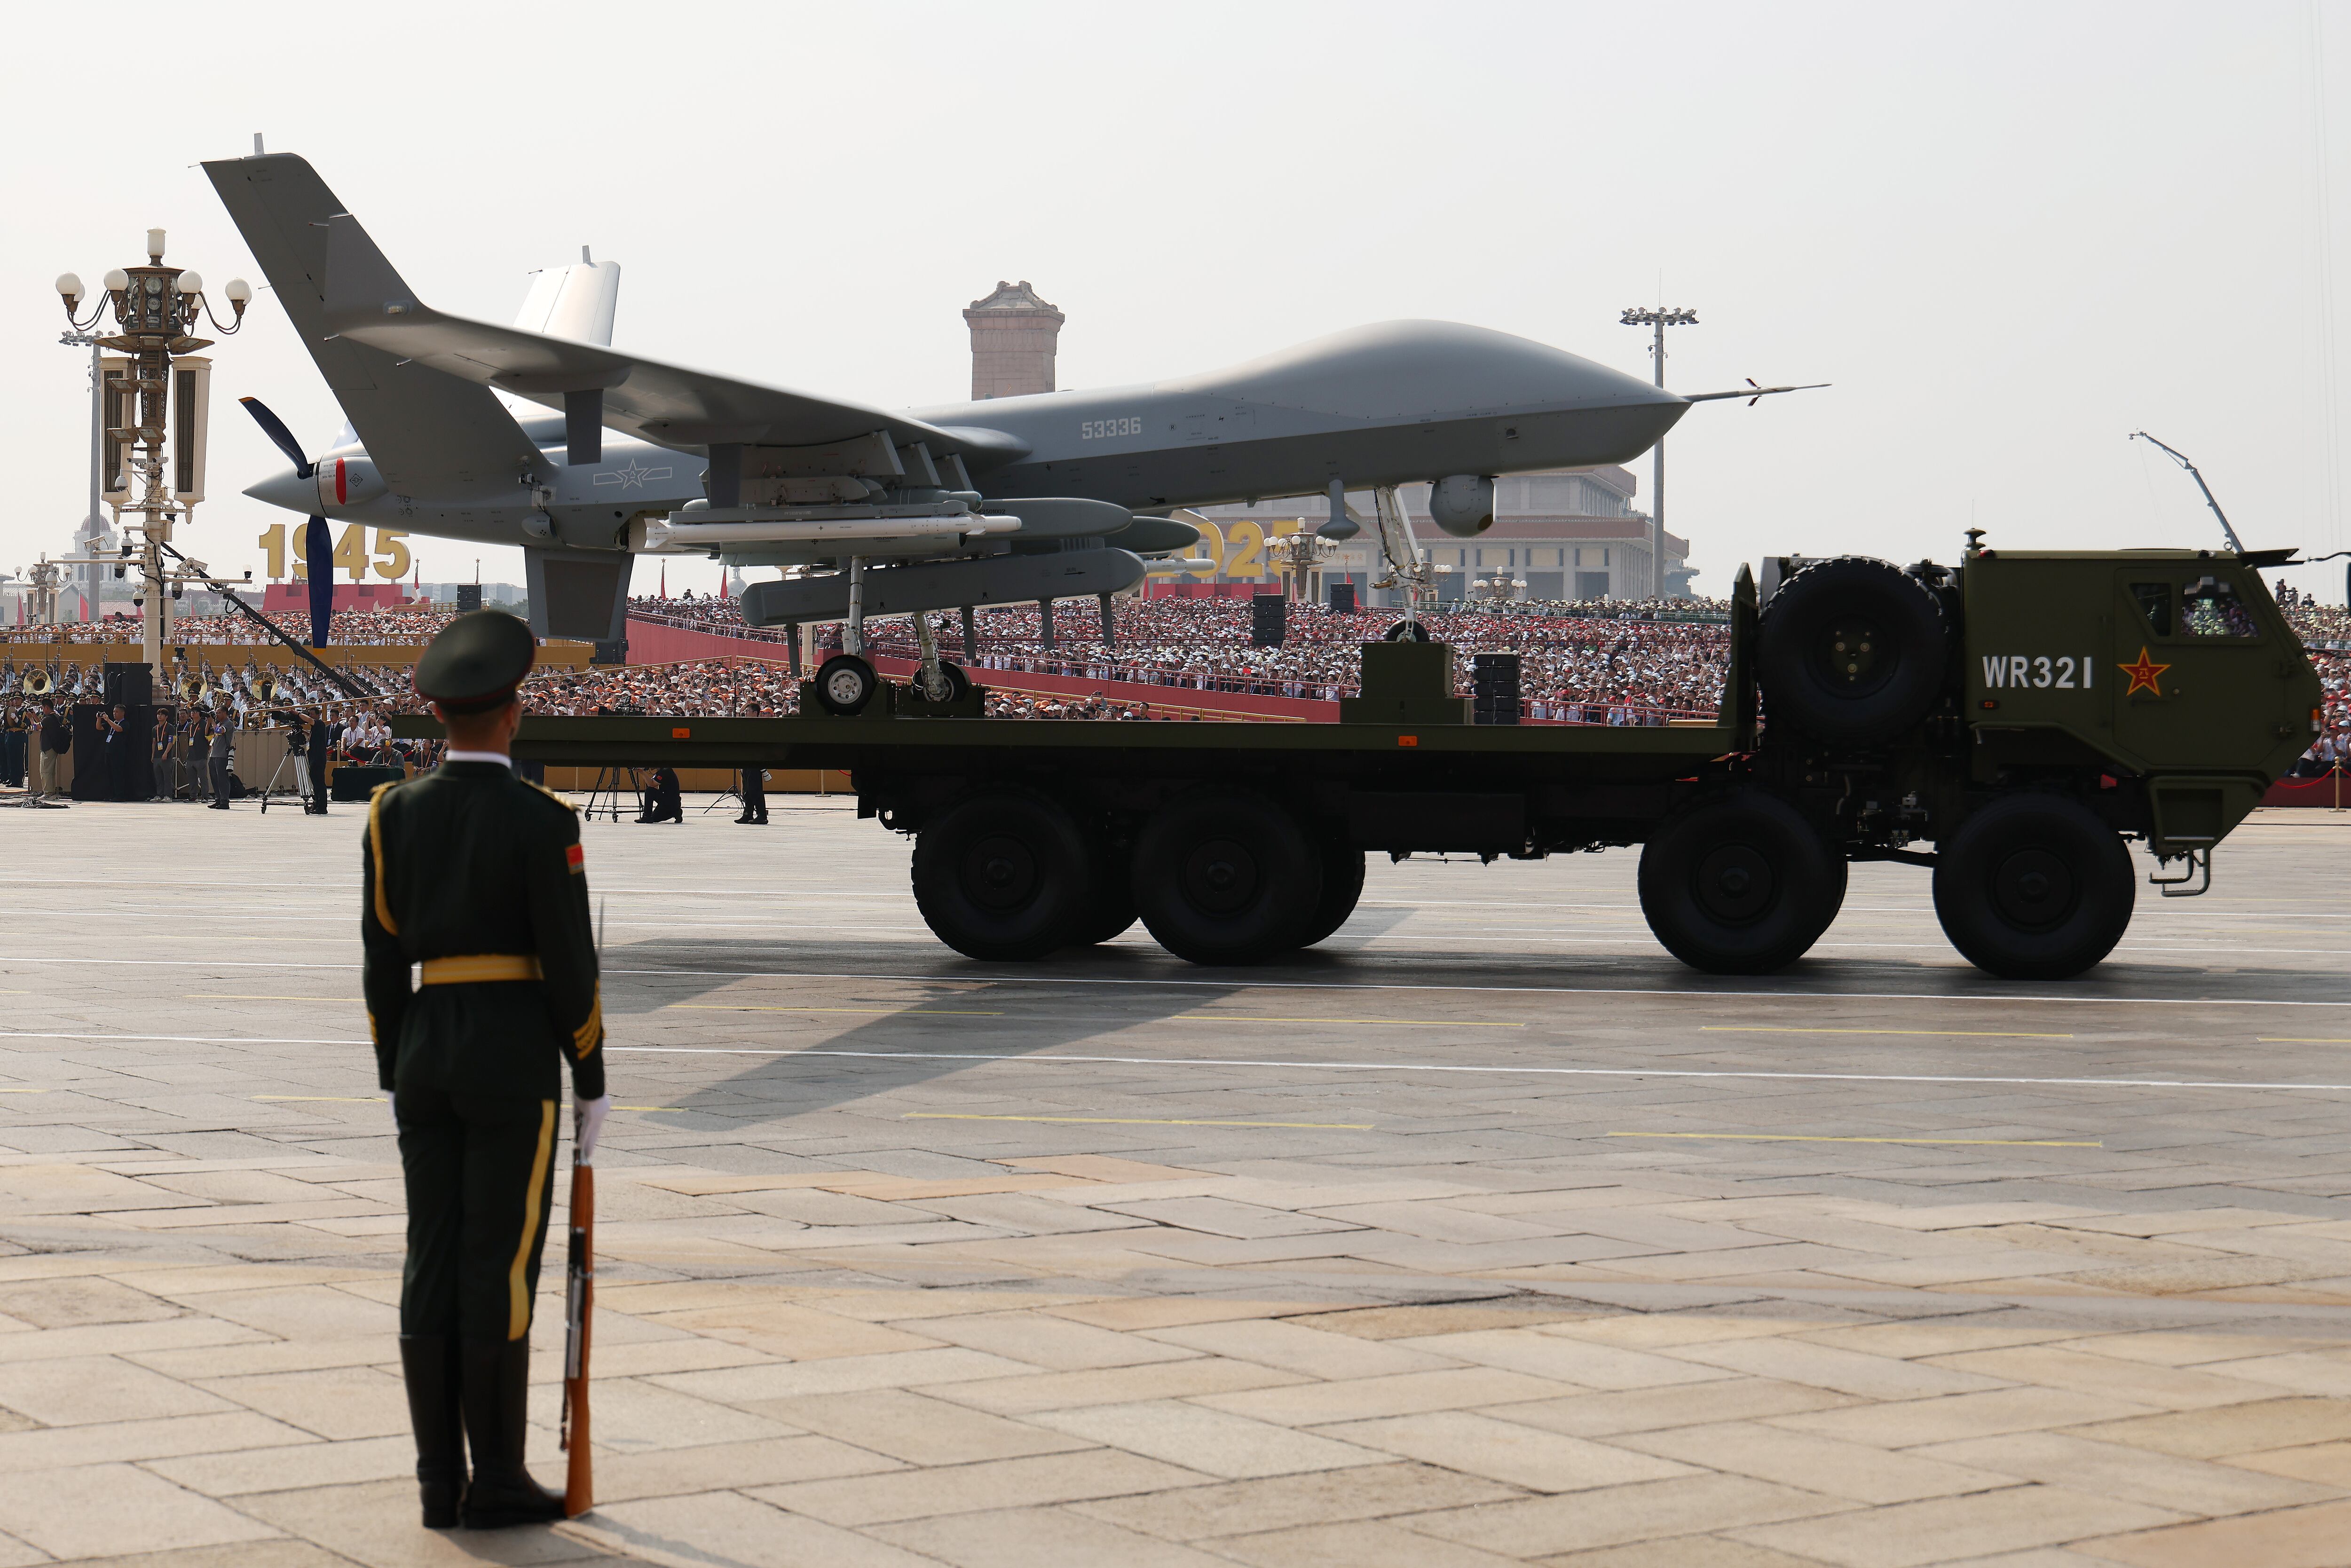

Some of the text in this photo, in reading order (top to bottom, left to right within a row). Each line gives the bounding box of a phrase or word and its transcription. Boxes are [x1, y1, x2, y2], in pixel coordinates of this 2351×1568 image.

[1082, 417, 1141, 439] 53336
[1146, 521, 1300, 578] 025
[1982, 656, 2091, 688] WR321
